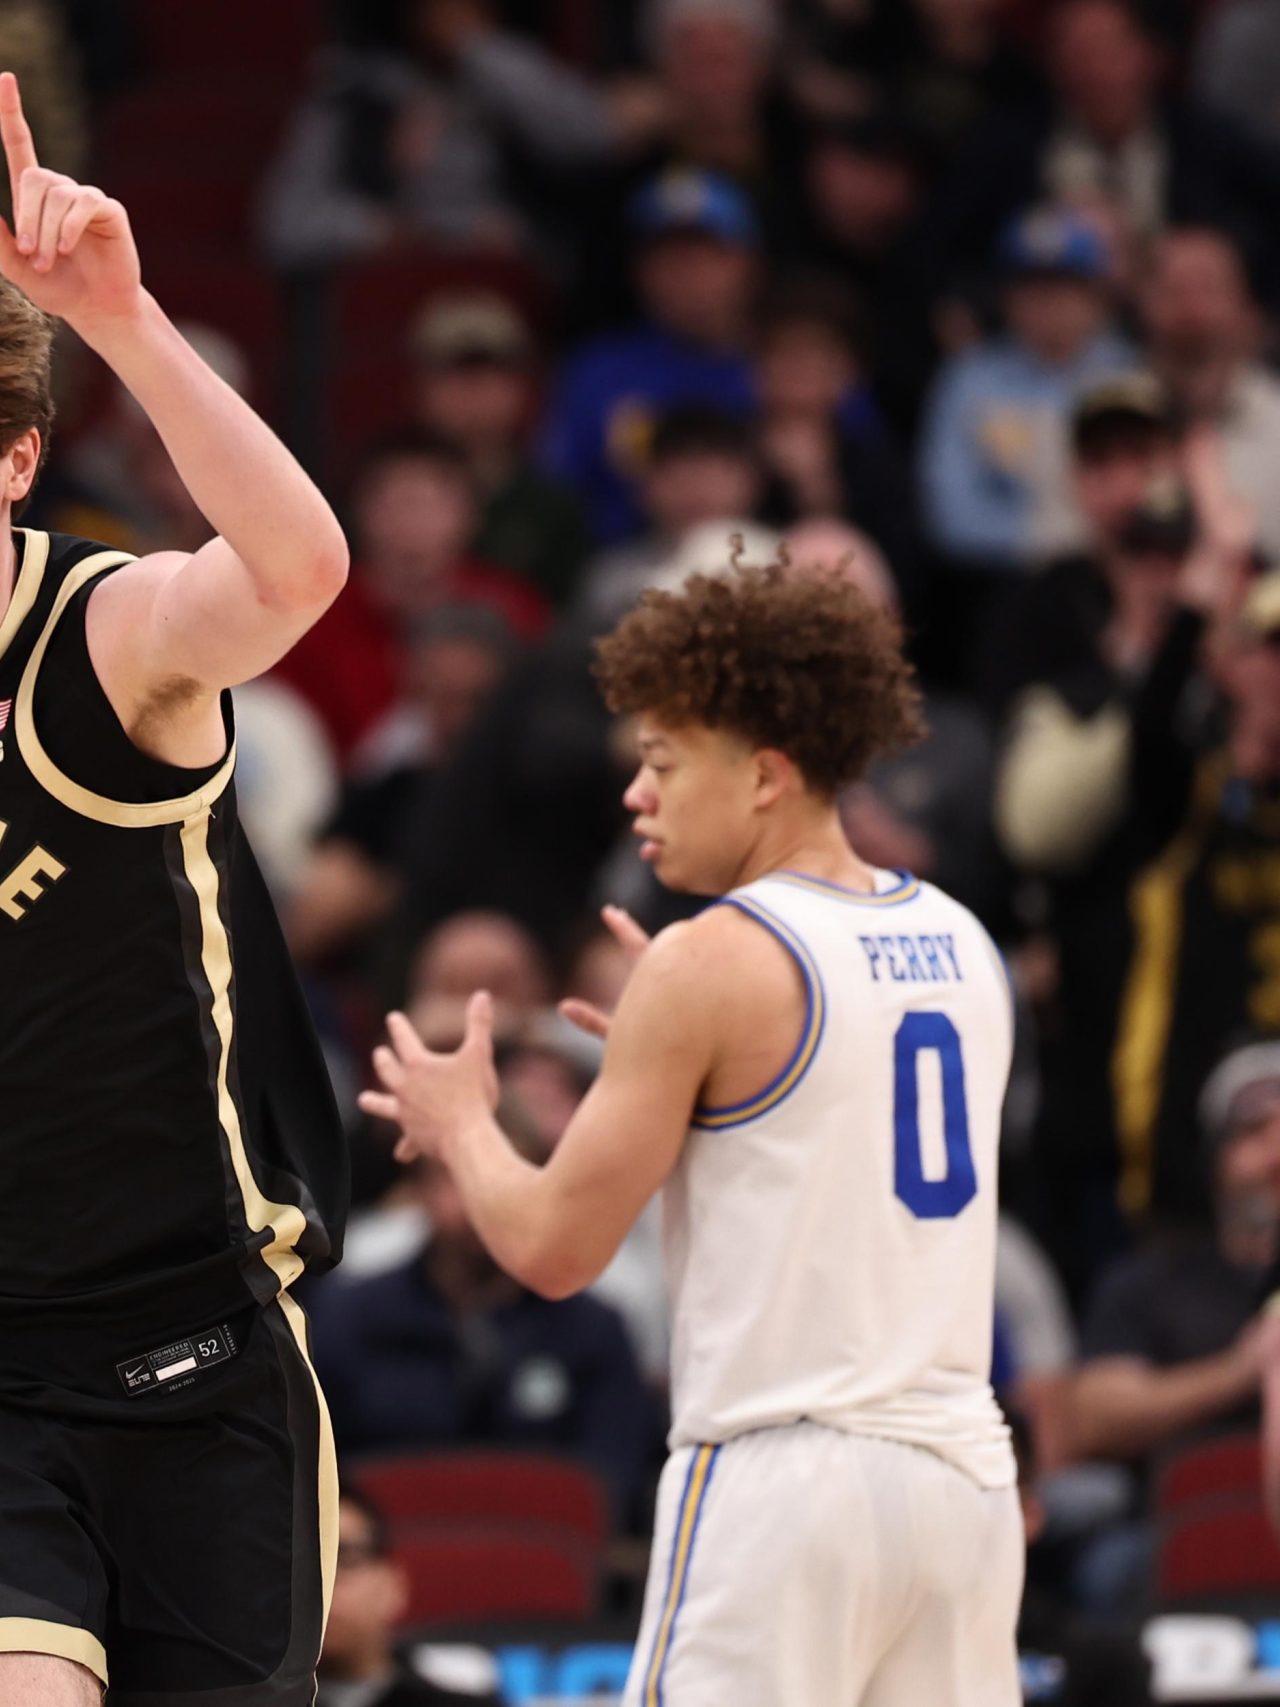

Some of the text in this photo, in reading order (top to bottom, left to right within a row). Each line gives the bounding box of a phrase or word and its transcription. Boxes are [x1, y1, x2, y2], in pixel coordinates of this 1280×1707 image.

[858, 934, 963, 982] PERRY
[893, 1011, 978, 1219] 0
[198, 1339, 220, 1357] 52
